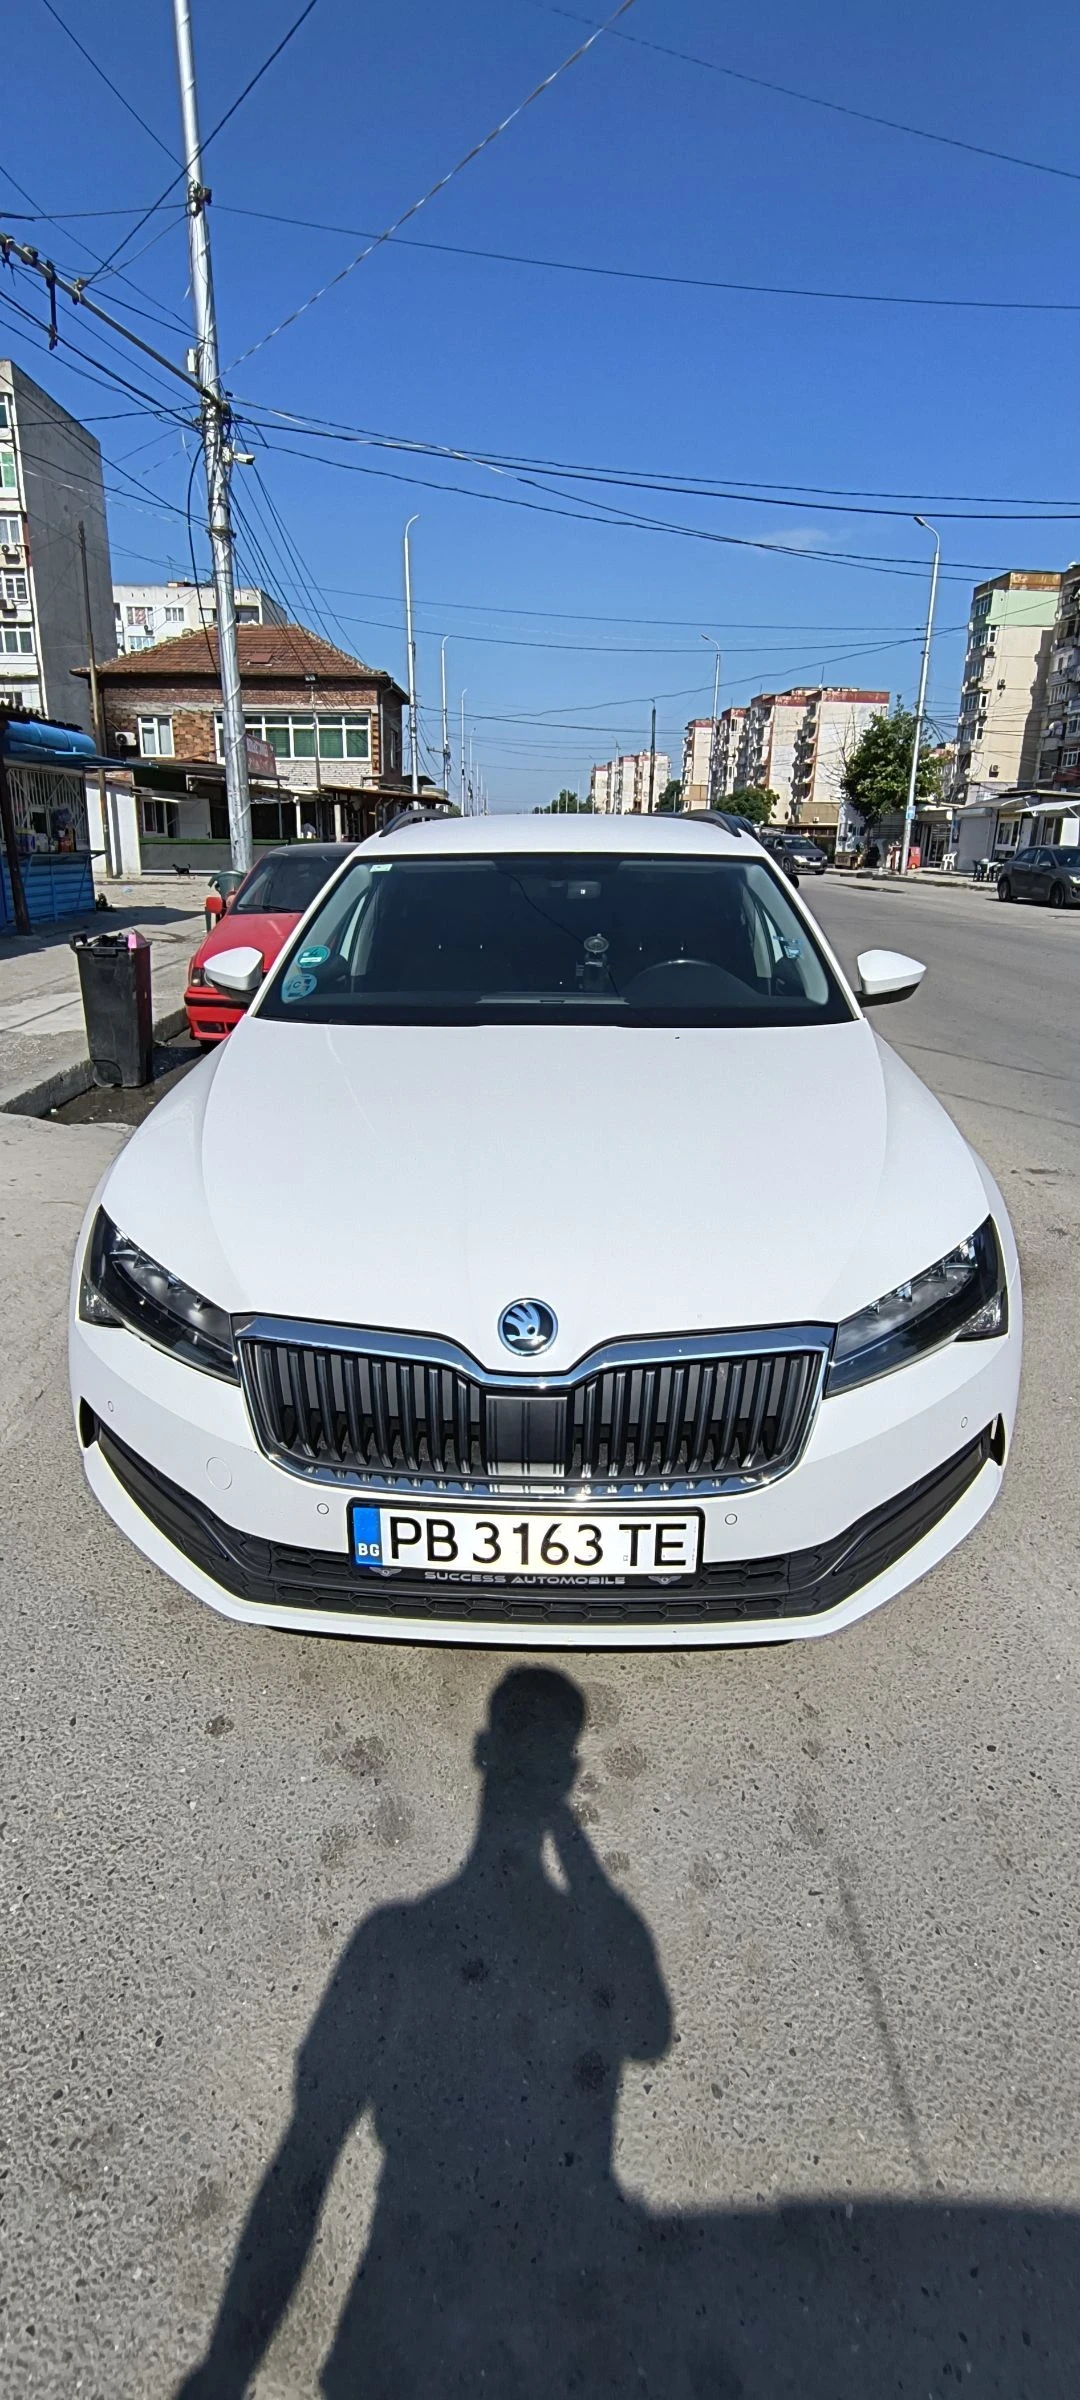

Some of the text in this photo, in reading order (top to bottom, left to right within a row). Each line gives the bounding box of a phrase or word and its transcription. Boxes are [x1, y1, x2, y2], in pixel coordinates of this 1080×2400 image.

[389, 1516, 687, 1567] PB 3163 TE
[358, 1543, 380, 1557] BG
[424, 1571, 626, 1585] SUCCESS AUTOMOBILE
